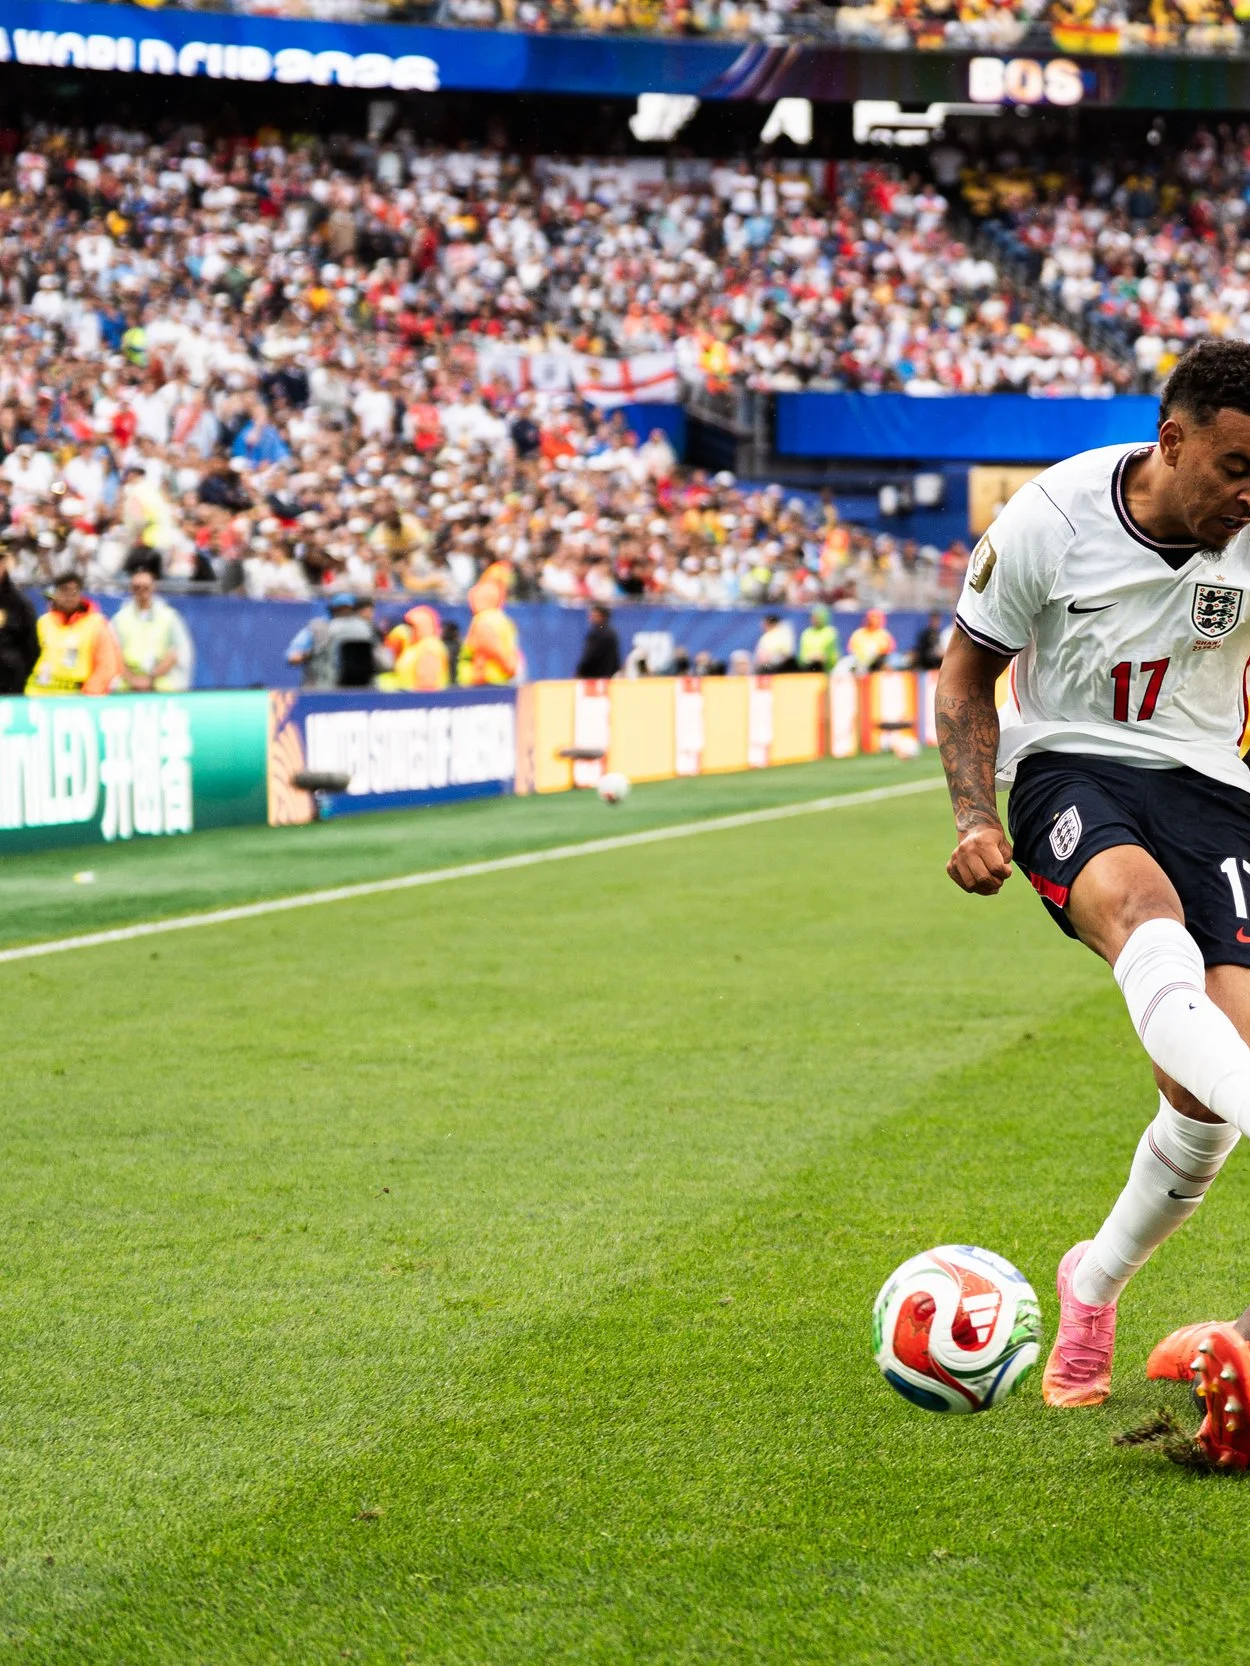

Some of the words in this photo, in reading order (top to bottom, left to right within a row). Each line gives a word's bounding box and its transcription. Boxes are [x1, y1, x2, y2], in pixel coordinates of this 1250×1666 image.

[13, 27, 177, 75] WORLD
[179, 41, 272, 83] CUP
[968, 57, 1085, 105] BOS
[1110, 656, 1171, 723] 17
